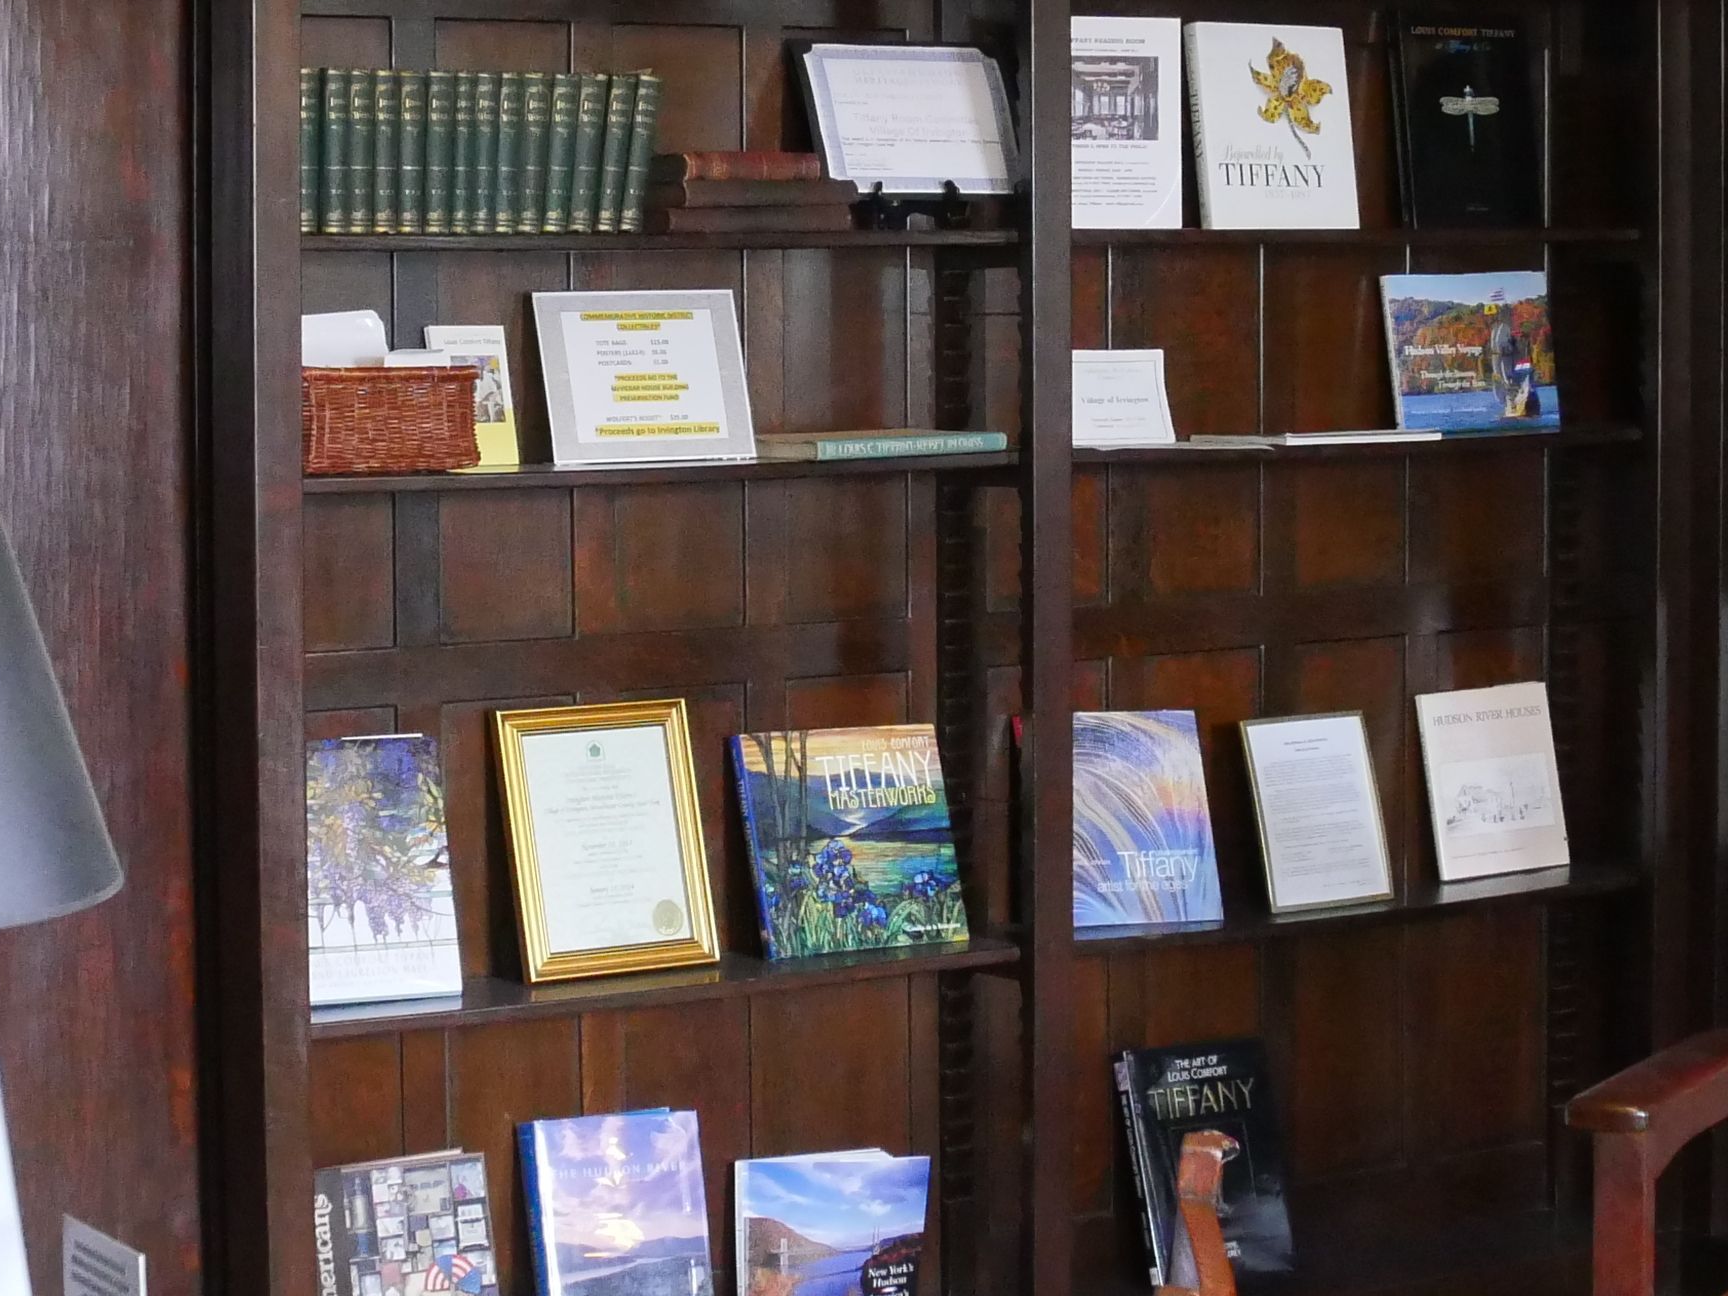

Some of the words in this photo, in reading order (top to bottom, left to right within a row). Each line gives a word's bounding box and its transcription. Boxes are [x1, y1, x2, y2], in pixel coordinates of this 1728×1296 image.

[1438, 27, 1478, 36] COMFORT
[1218, 162, 1325, 188] TIFFANY
[657, 425, 692, 437] Irvington
[693, 424, 720, 435] Library
[1433, 713, 1472, 727] HUDSON
[1476, 709, 1503, 723] RIVER
[1506, 705, 1541, 720] HOUSES
[862, 737, 887, 751] LOUIS
[891, 735, 930, 750] COMFORT
[815, 750, 934, 793] TIFFANY
[828, 785, 936, 810] MASTERWORKS
[1117, 850, 1199, 882] Tiffany
[1175, 1058, 1190, 1070] THE
[1192, 1056, 1205, 1068] ART
[1207, 1055, 1218, 1066] OF
[1168, 1068, 1190, 1083] LOUIS
[1191, 1065, 1228, 1080] COMFORT
[1146, 1078, 1254, 1121] TIFFANY
[583, 1163, 641, 1179] HUDON
[868, 1268, 887, 1278] New
[873, 1276, 907, 1288] Hudson
